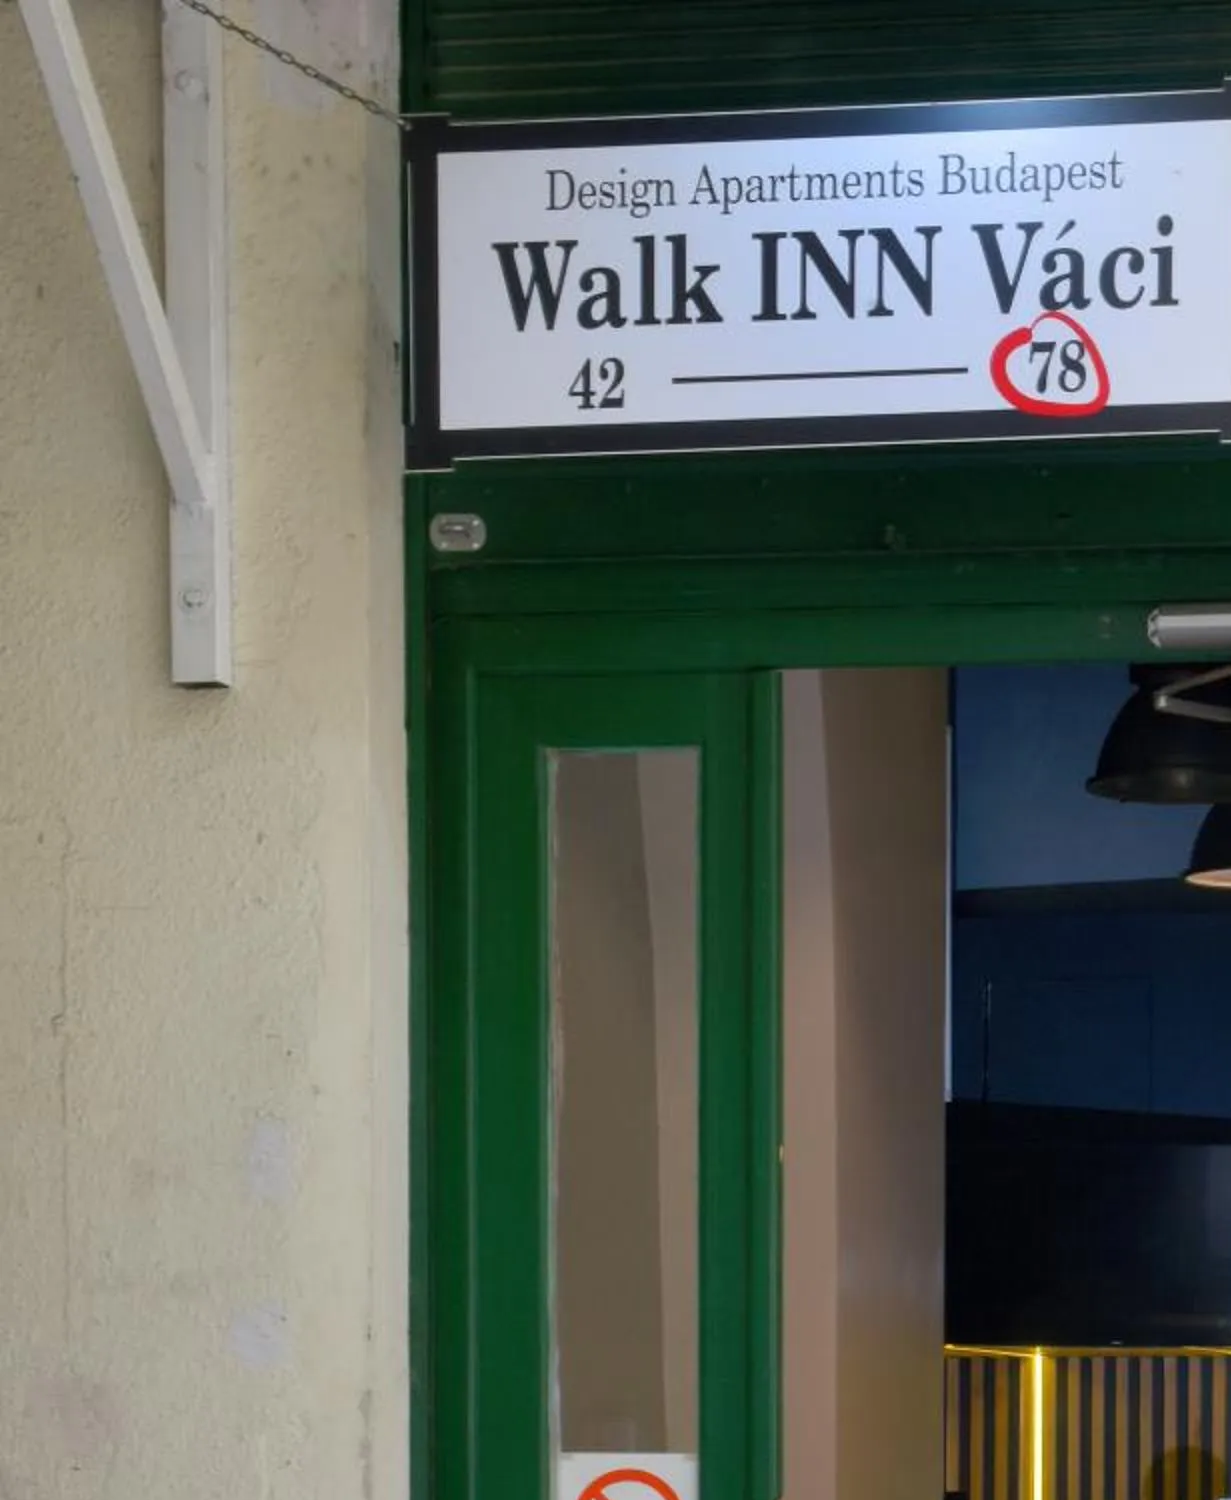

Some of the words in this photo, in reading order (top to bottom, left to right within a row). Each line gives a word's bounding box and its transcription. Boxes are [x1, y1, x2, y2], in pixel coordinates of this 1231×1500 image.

[546, 170, 675, 218] Design
[688, 165, 924, 215] Apartments
[938, 152, 1123, 202] Budapest
[492, 234, 723, 331] Walk
[752, 226, 942, 321] INN
[971, 215, 1178, 314] Váci
[569, 358, 624, 409] 42
[1030, 340, 1086, 393] 78
